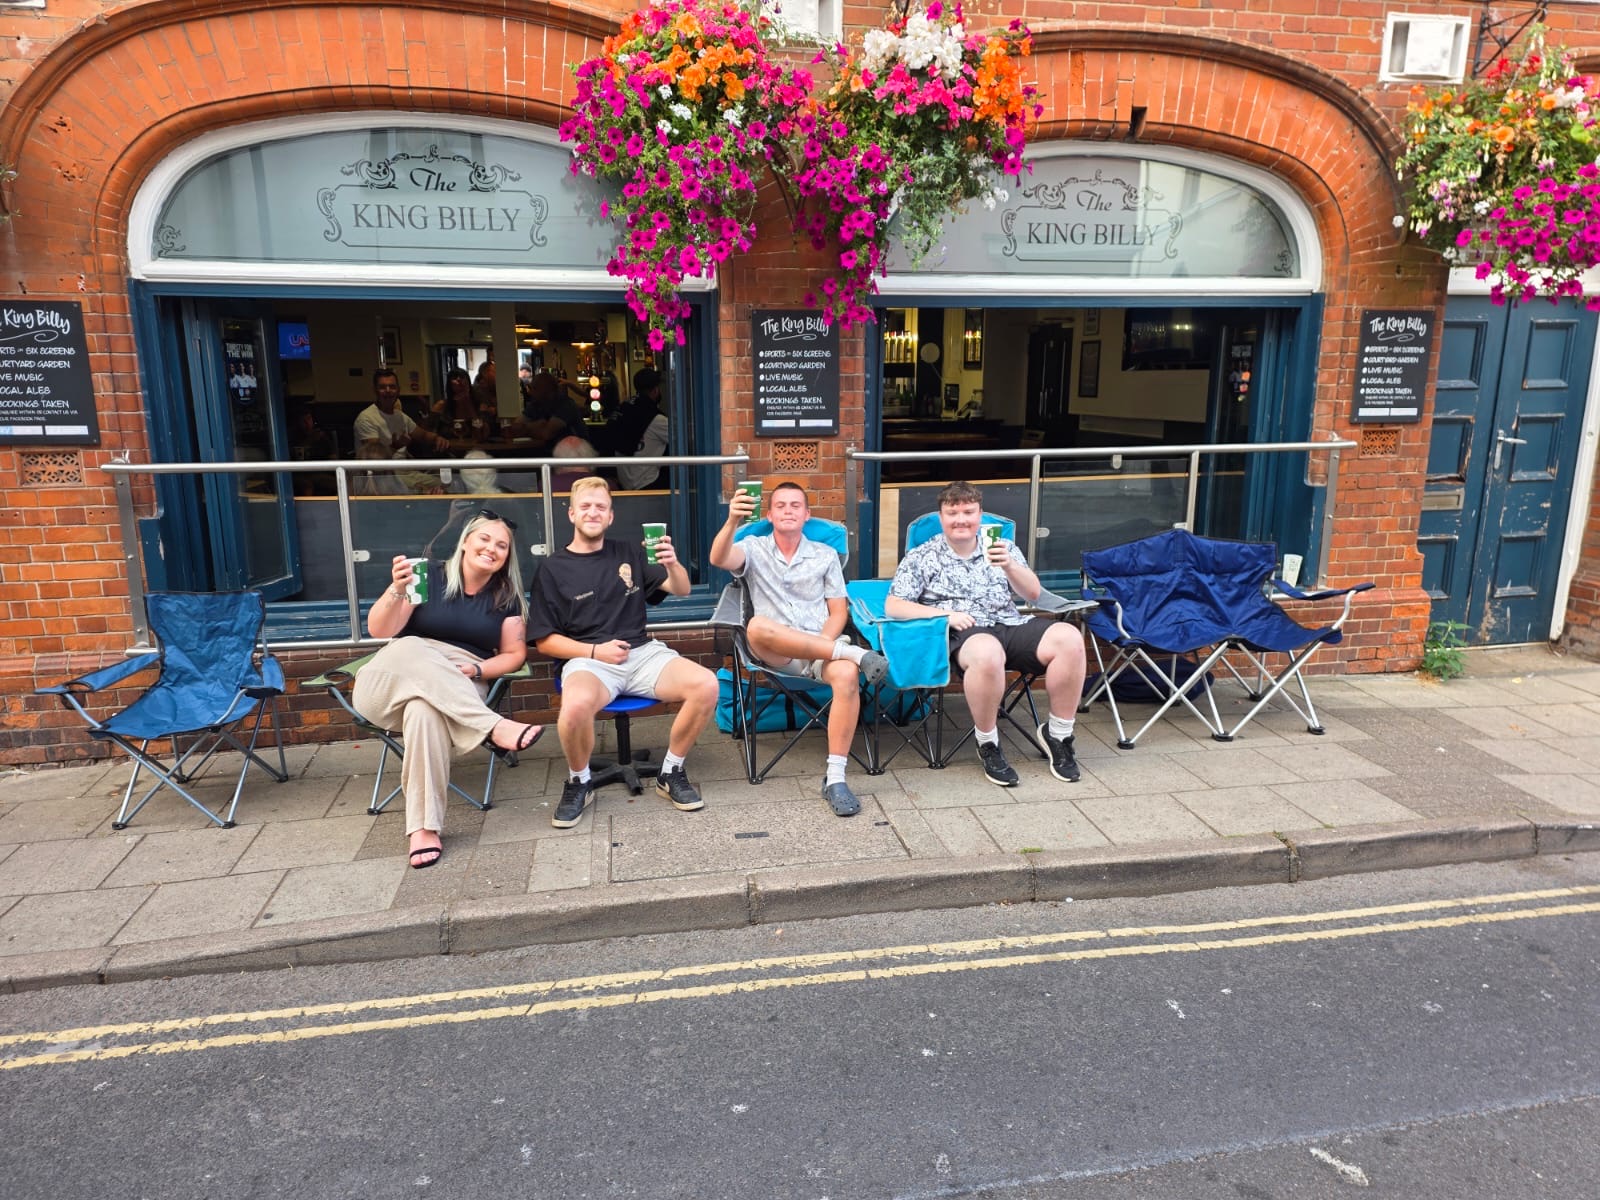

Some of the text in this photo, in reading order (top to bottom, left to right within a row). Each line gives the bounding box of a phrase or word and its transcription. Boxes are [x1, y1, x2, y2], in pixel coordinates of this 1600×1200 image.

[409, 167, 456, 192] The
[1076, 190, 1113, 211] The
[351, 203, 521, 232] KING BILLY
[1026, 222, 1161, 247] KING BILLY
[3, 308, 34, 329] King
[35, 309, 71, 335] Billy
[760, 316, 829, 337] The King Billy
[1369, 316, 1427, 337] The King Billy
[25, 346, 39, 355] SIX
[39, 346, 76, 355] SCREENS
[764, 350, 786, 358] SPORTS
[803, 350, 832, 358] SCREENS
[37, 360, 71, 369] GARDEN
[764, 361, 826, 369] COURTYARD GARDEN
[14, 373, 44, 382] MUSIC
[765, 373, 804, 381] LIVE MUSIC
[26, 386, 51, 395] ALES
[766, 385, 788, 393] LOCAL
[41, 399, 70, 408] TAKEN
[801, 396, 823, 404] TAKEN
